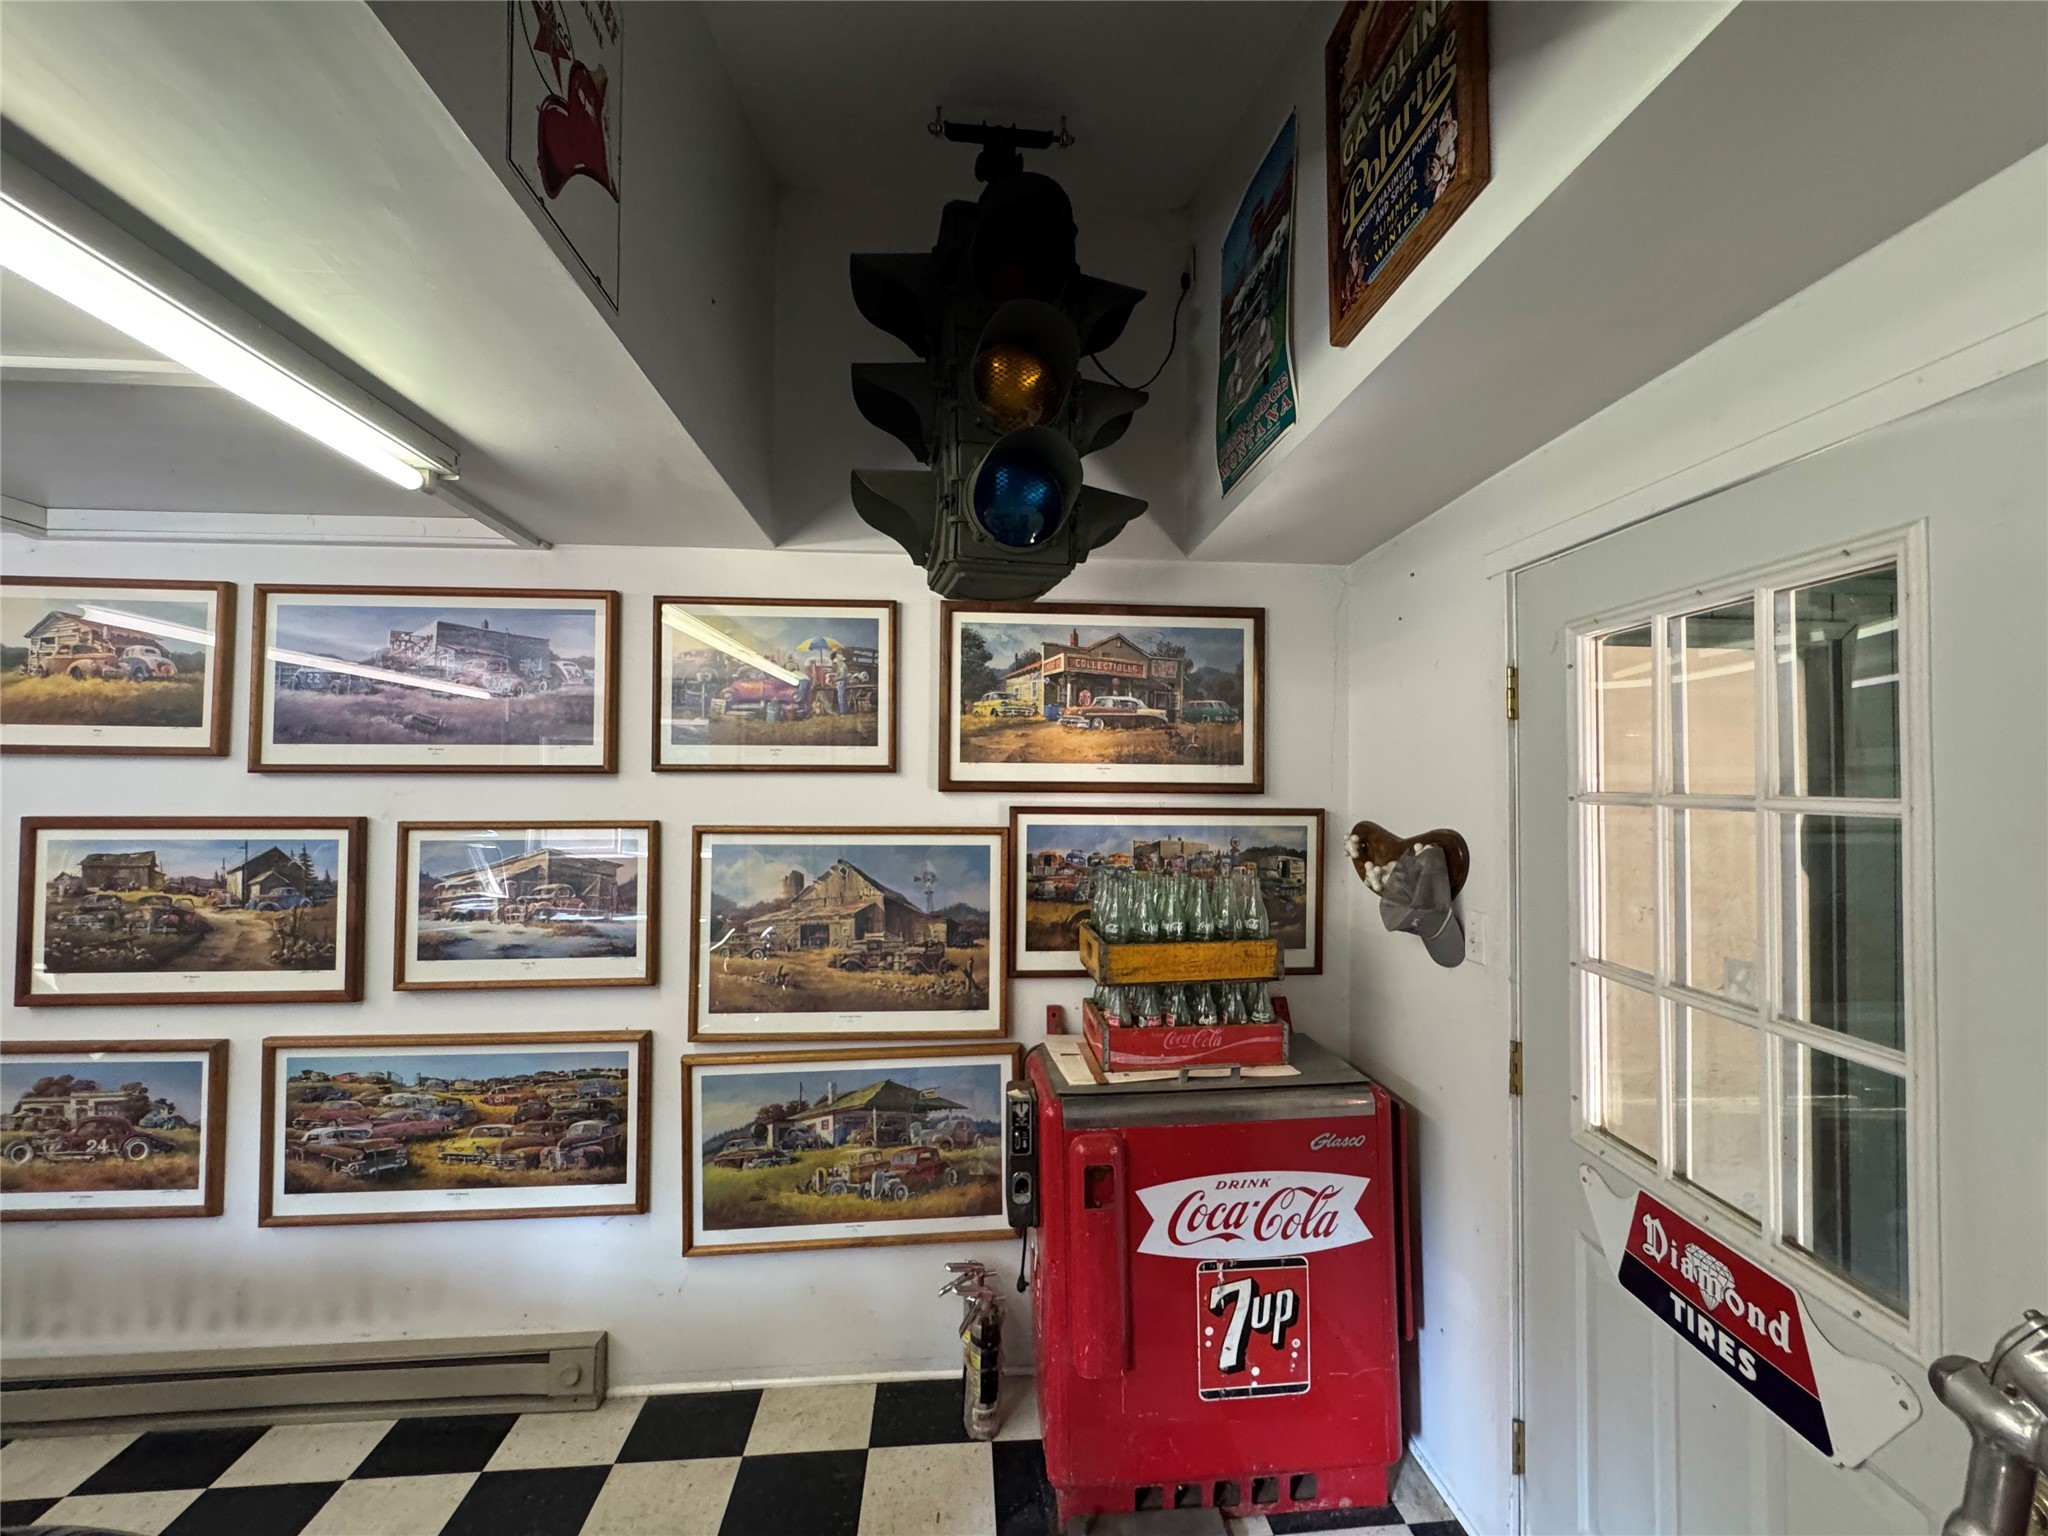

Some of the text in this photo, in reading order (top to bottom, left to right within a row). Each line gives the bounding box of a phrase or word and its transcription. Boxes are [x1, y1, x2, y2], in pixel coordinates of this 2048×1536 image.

[1341, 28, 1458, 245] Polarine
[1378, 159, 1412, 210] MAXIMUM
[1411, 117, 1439, 164] POWER
[1372, 178, 1419, 245] SUMMER
[1375, 165, 1415, 226] AND SPEED
[1374, 201, 1420, 263] WINTER
[1245, 371, 1289, 432] LODGE
[1219, 394, 1293, 482] MONTANA
[307, 672, 320, 684] 22
[1163, 1028, 1224, 1050] Coca-Cola
[86, 1138, 110, 1154] 24
[1311, 1132, 1366, 1151] Glasco
[1215, 1177, 1273, 1191] DRINK
[1167, 1184, 1344, 1247] Coca-Cola
[1642, 1213, 1793, 1354] Diamond
[1669, 1291, 1758, 1382] TIRES
